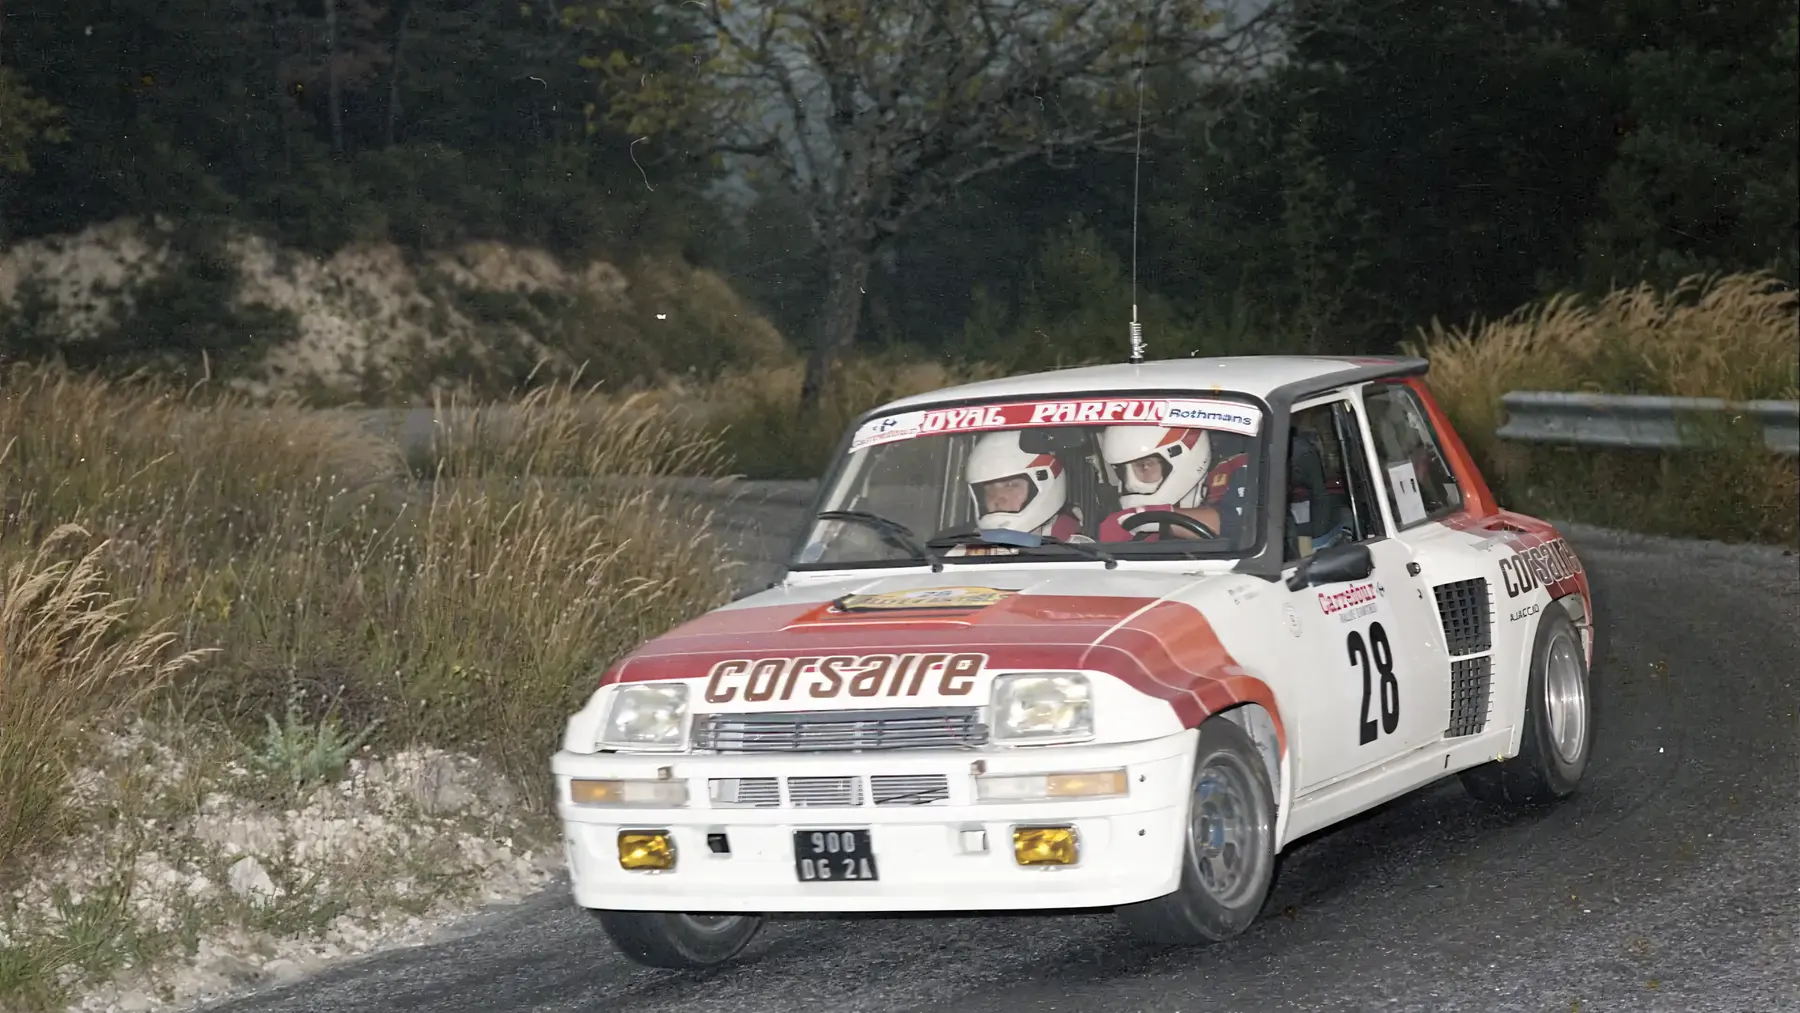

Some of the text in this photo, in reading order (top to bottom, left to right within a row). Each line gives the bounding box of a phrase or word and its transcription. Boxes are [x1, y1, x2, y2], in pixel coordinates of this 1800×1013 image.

[919, 406, 1007, 432] OYAL
[1168, 407, 1253, 426] Rothmans
[704, 653, 989, 704] corsaire
[1347, 621, 1400, 746] 28
[811, 831, 856, 854] 900
[801, 857, 873, 879] DG 2A
